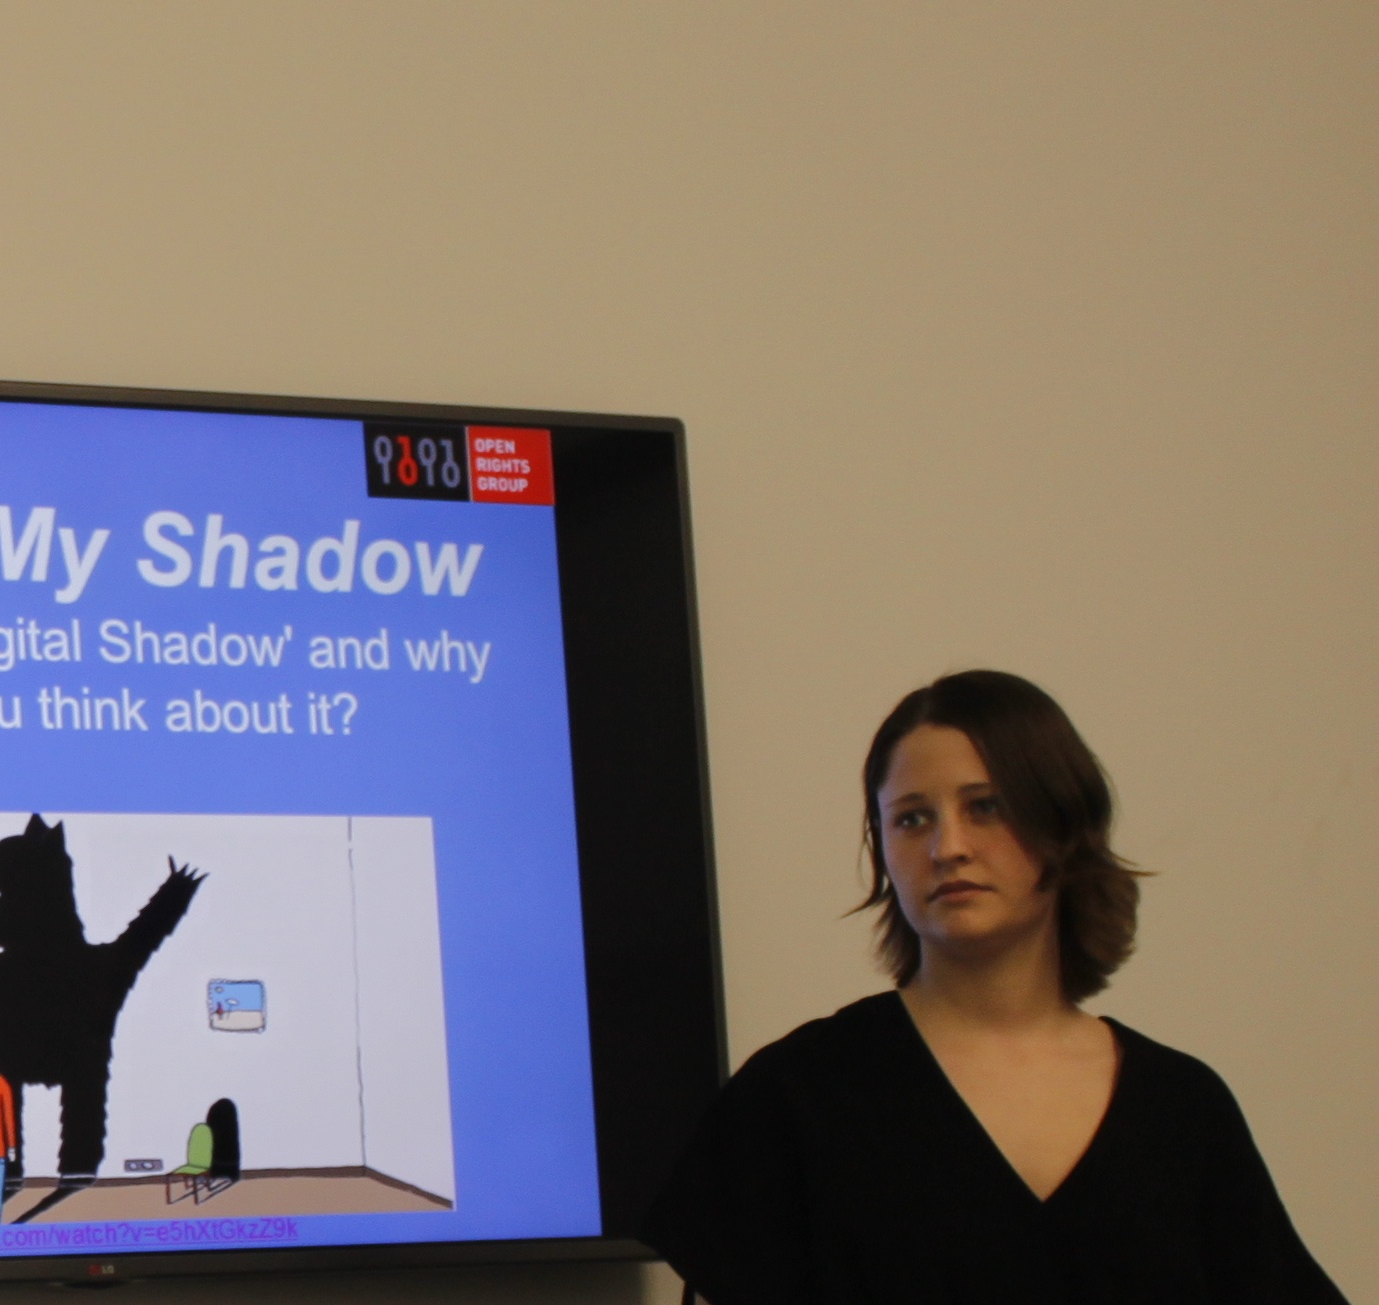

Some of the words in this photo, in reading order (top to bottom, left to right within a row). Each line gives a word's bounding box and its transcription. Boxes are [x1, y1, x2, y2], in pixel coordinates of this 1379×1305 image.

[474, 438, 516, 454] OPEN
[476, 457, 531, 474] RIGHTS
[477, 476, 529, 492] GROUP
[137, 510, 484, 597] Shadow
[99, 618, 293, 667] Shadow'
[309, 628, 390, 670] and
[404, 630, 490, 684] why
[38, 686, 149, 731] think
[166, 690, 293, 734] about
[308, 692, 359, 735] it?
